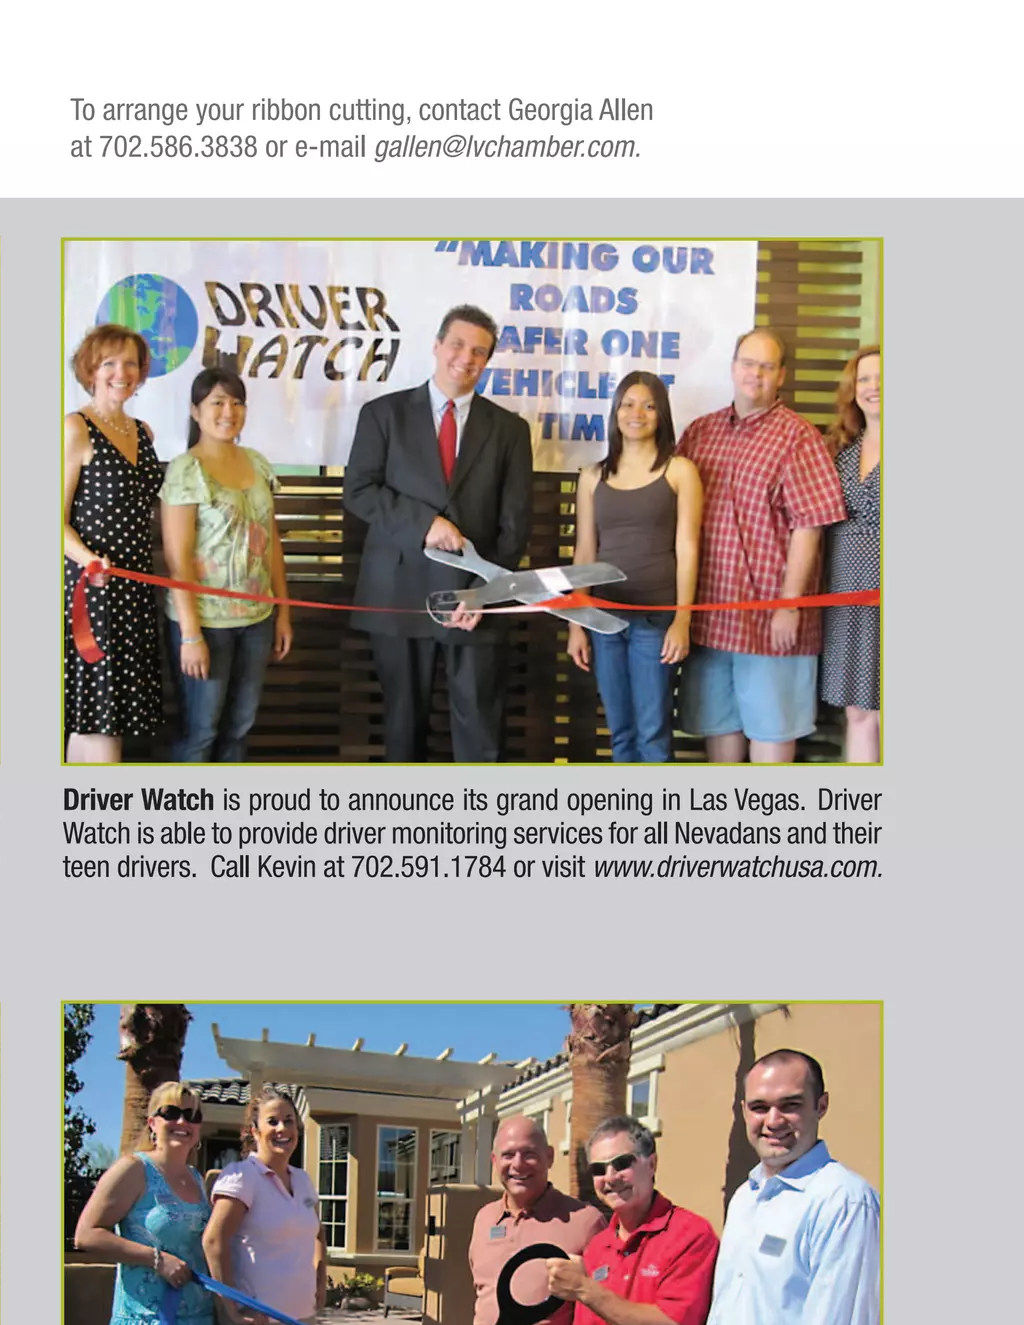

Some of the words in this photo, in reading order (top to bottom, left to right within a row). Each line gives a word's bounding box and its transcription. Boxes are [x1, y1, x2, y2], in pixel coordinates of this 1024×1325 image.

[69, 97, 96, 121] To
[102, 102, 188, 127] arrange
[195, 102, 245, 126] your
[252, 97, 321, 121] ribbon
[329, 97, 411, 127] cutting,
[418, 98, 502, 121] contact
[508, 97, 594, 126] Georgia
[598, 97, 653, 121] Allen
[70, 135, 93, 158] at
[99, 134, 258, 158] 702.586.3838
[265, 139, 289, 158] or
[295, 134, 366, 158] e-mail
[374, 134, 640, 163] gallen@lvchamber.com.
[632, 245, 714, 275] OUR
[205, 281, 400, 332] DRIVER
[509, 283, 638, 315] ROADS
[202, 326, 400, 381] WATCH
[496, 326, 588, 355] AFER
[601, 329, 680, 359] ONE
[538, 413, 605, 441] TIM
[63, 787, 134, 812] Driver
[140, 787, 214, 812] Watch
[223, 787, 241, 812] is
[249, 787, 311, 817] proud
[318, 788, 340, 812] to
[348, 792, 455, 812] announce
[463, 787, 489, 812] its
[496, 787, 558, 817] grand
[567, 787, 653, 817] opening
[662, 787, 681, 811] in
[690, 787, 728, 812] Las
[733, 787, 806, 817] Vegas.
[818, 787, 883, 812] Driver
[62, 855, 110, 878] teen
[117, 854, 197, 879] drivers.
[210, 854, 250, 878] Call
[258, 854, 316, 878] Kevin
[323, 855, 345, 878] at
[351, 854, 507, 879] 702.591.1784
[513, 859, 536, 878] or
[541, 854, 586, 878] visit
[594, 854, 883, 879] www.driverwatchusa.com.
